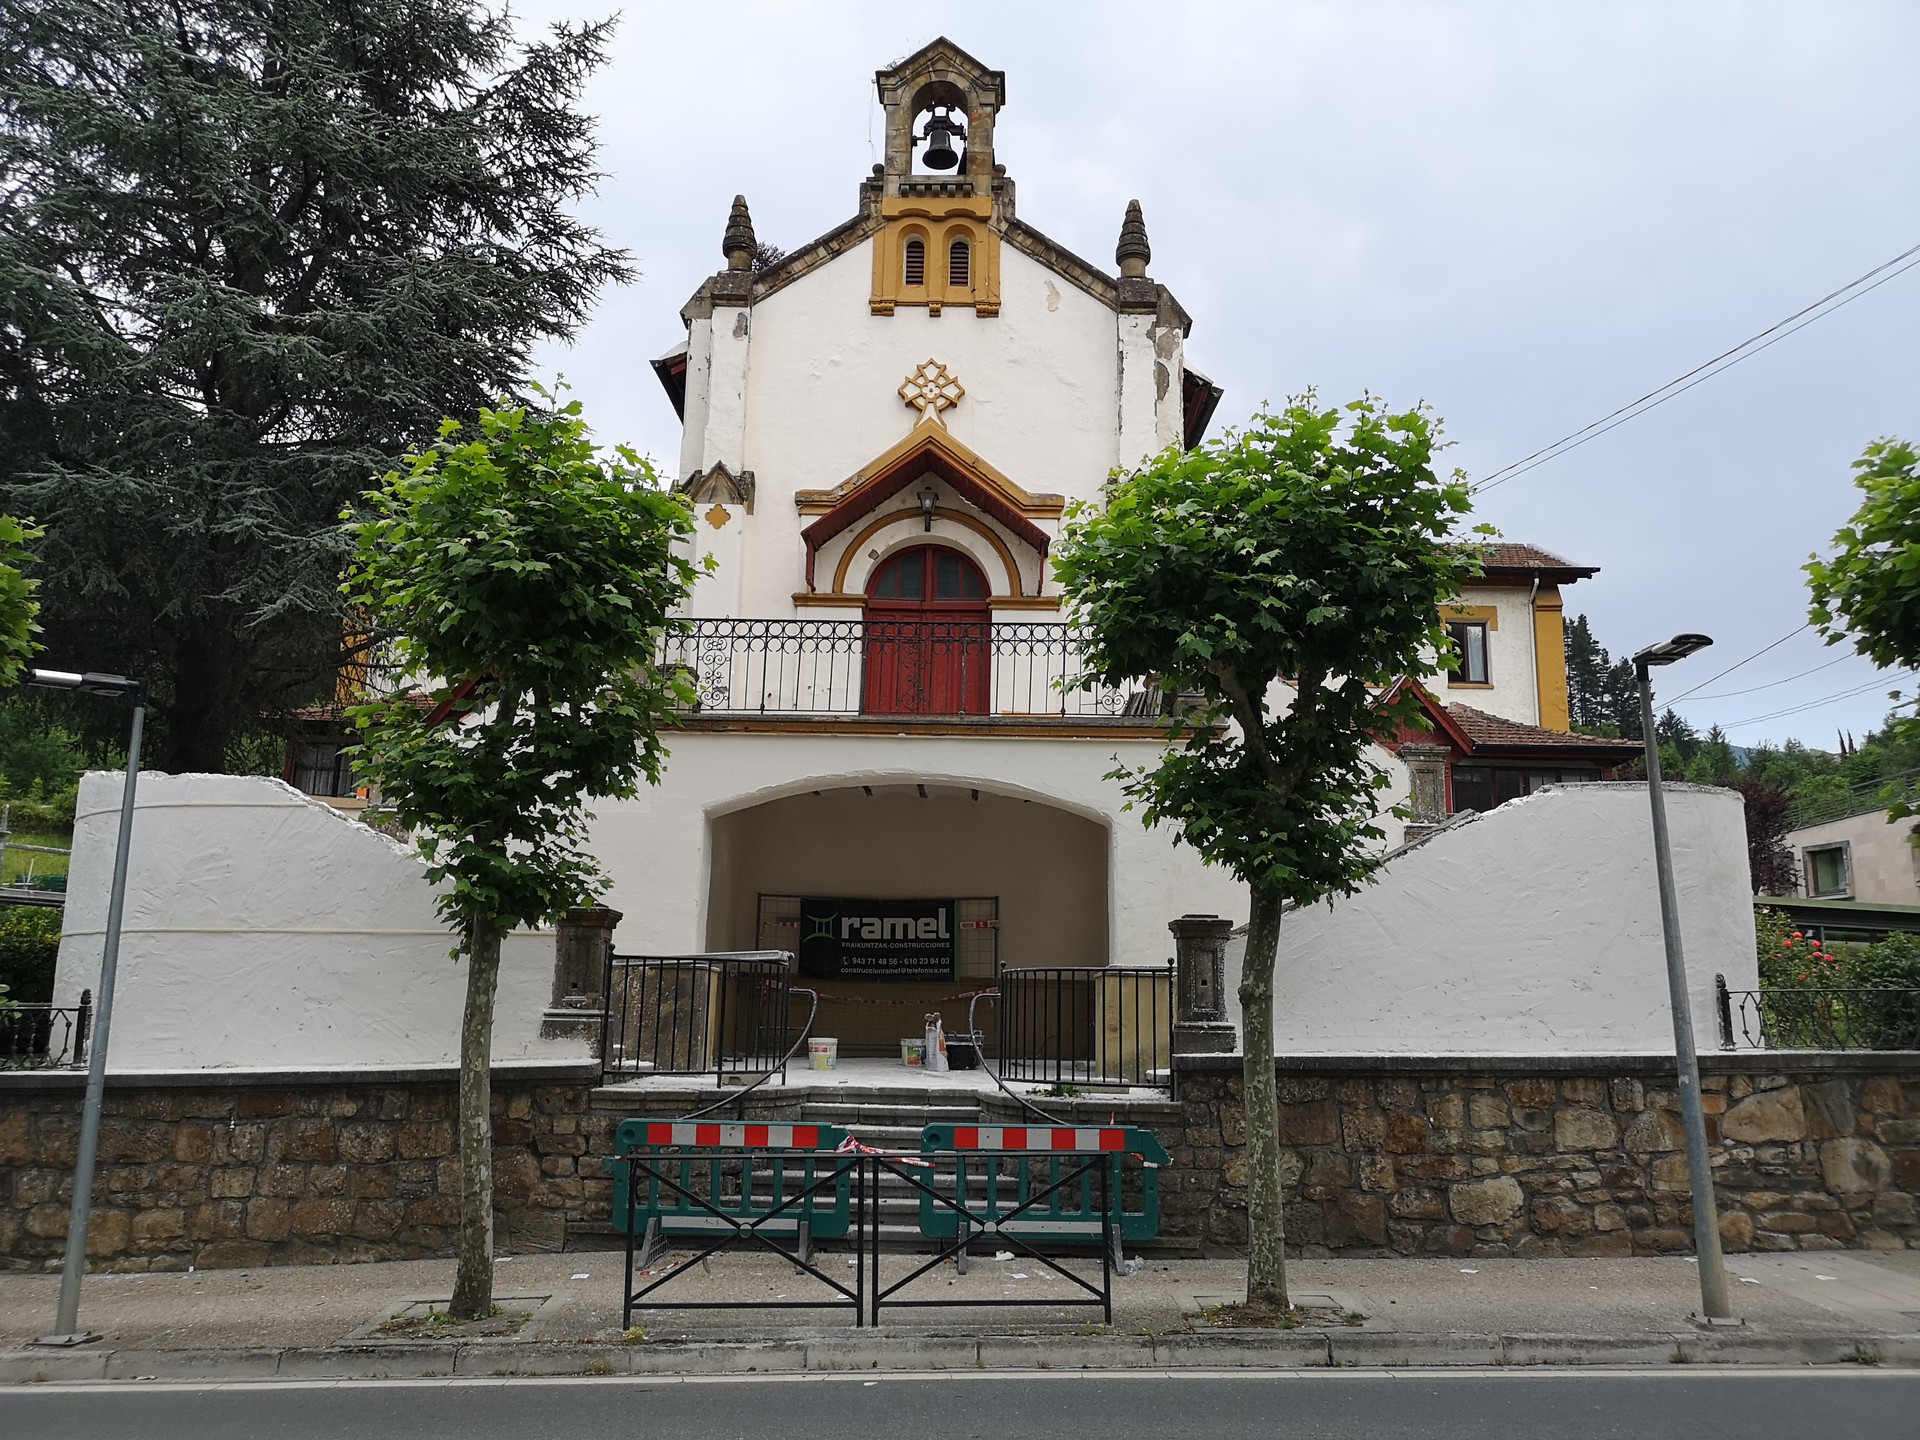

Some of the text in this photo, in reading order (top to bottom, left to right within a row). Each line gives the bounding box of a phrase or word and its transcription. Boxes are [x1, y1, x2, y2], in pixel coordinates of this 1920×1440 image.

[841, 907, 950, 939] ramel
[852, 957, 865, 965] 943
[919, 957, 929, 965] 23
[930, 957, 939, 965] 94
[941, 957, 950, 965] 03
